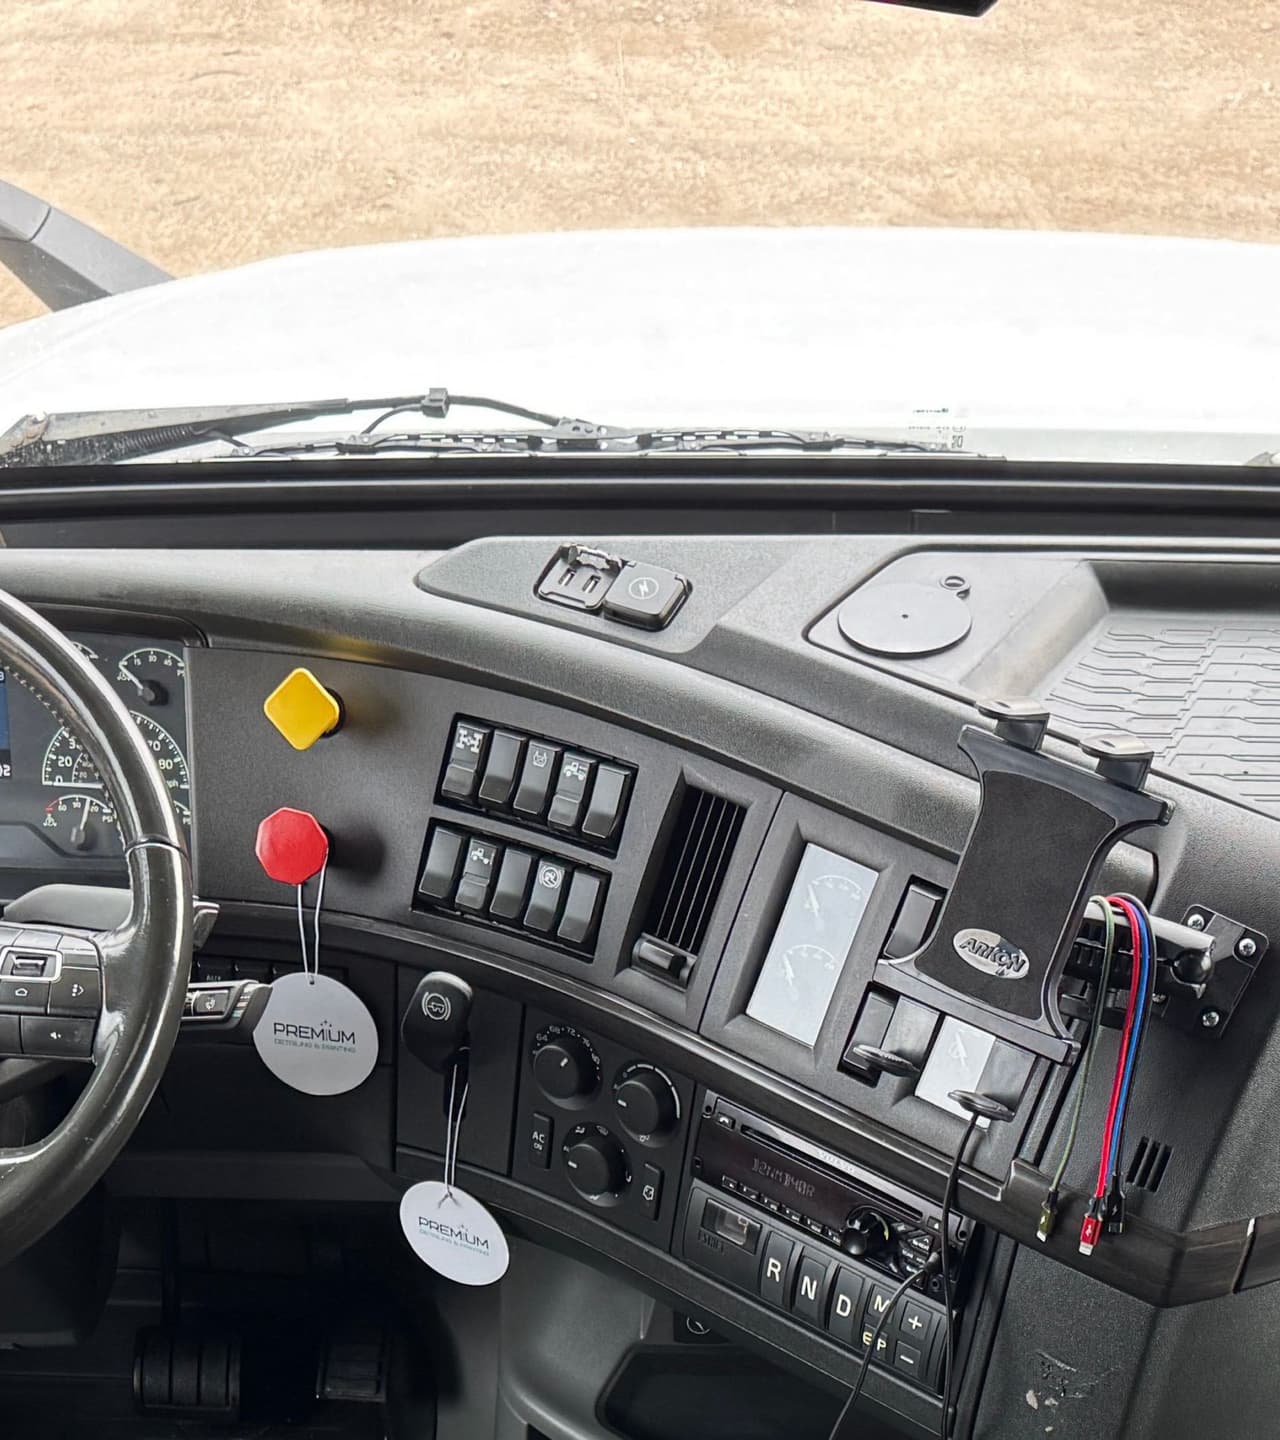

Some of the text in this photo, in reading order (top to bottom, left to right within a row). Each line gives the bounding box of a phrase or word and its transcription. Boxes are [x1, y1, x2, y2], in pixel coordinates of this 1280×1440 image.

[57, 755, 73, 767] 20
[158, 758, 174, 770] 80
[959, 937, 1027, 973] ARKON
[273, 1020, 356, 1045] PREMIUM
[532, 1131, 545, 1144] AC
[419, 1216, 489, 1249] PREMIUM
[766, 1259, 782, 1283] R
[801, 1275, 818, 1301] N
[836, 1294, 852, 1317] D
